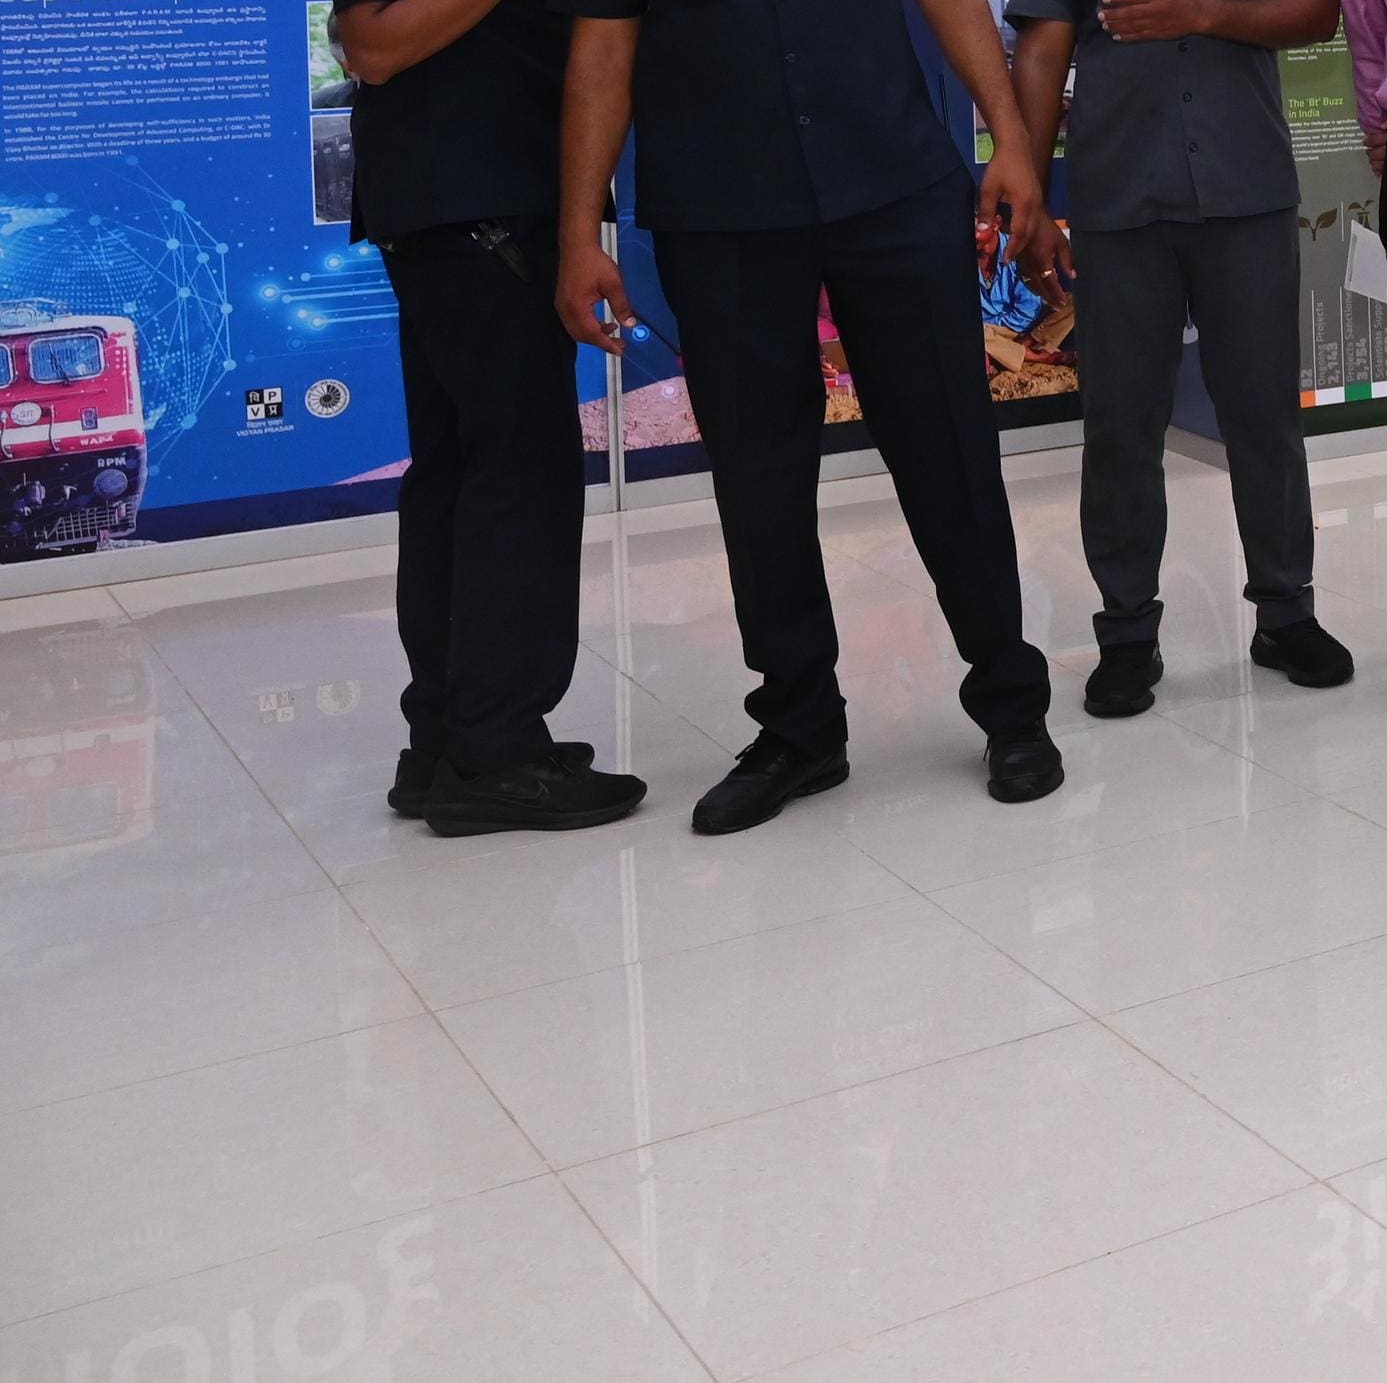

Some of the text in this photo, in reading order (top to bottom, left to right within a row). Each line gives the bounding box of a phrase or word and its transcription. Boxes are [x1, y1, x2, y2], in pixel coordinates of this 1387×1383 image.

[1287, 98, 1305, 108] The
[1322, 97, 1344, 106] Buzz
[1288, 108, 1320, 119] in India
[1315, 301, 1327, 342] Projects
[268, 391, 277, 401] P
[250, 407, 260, 417] V
